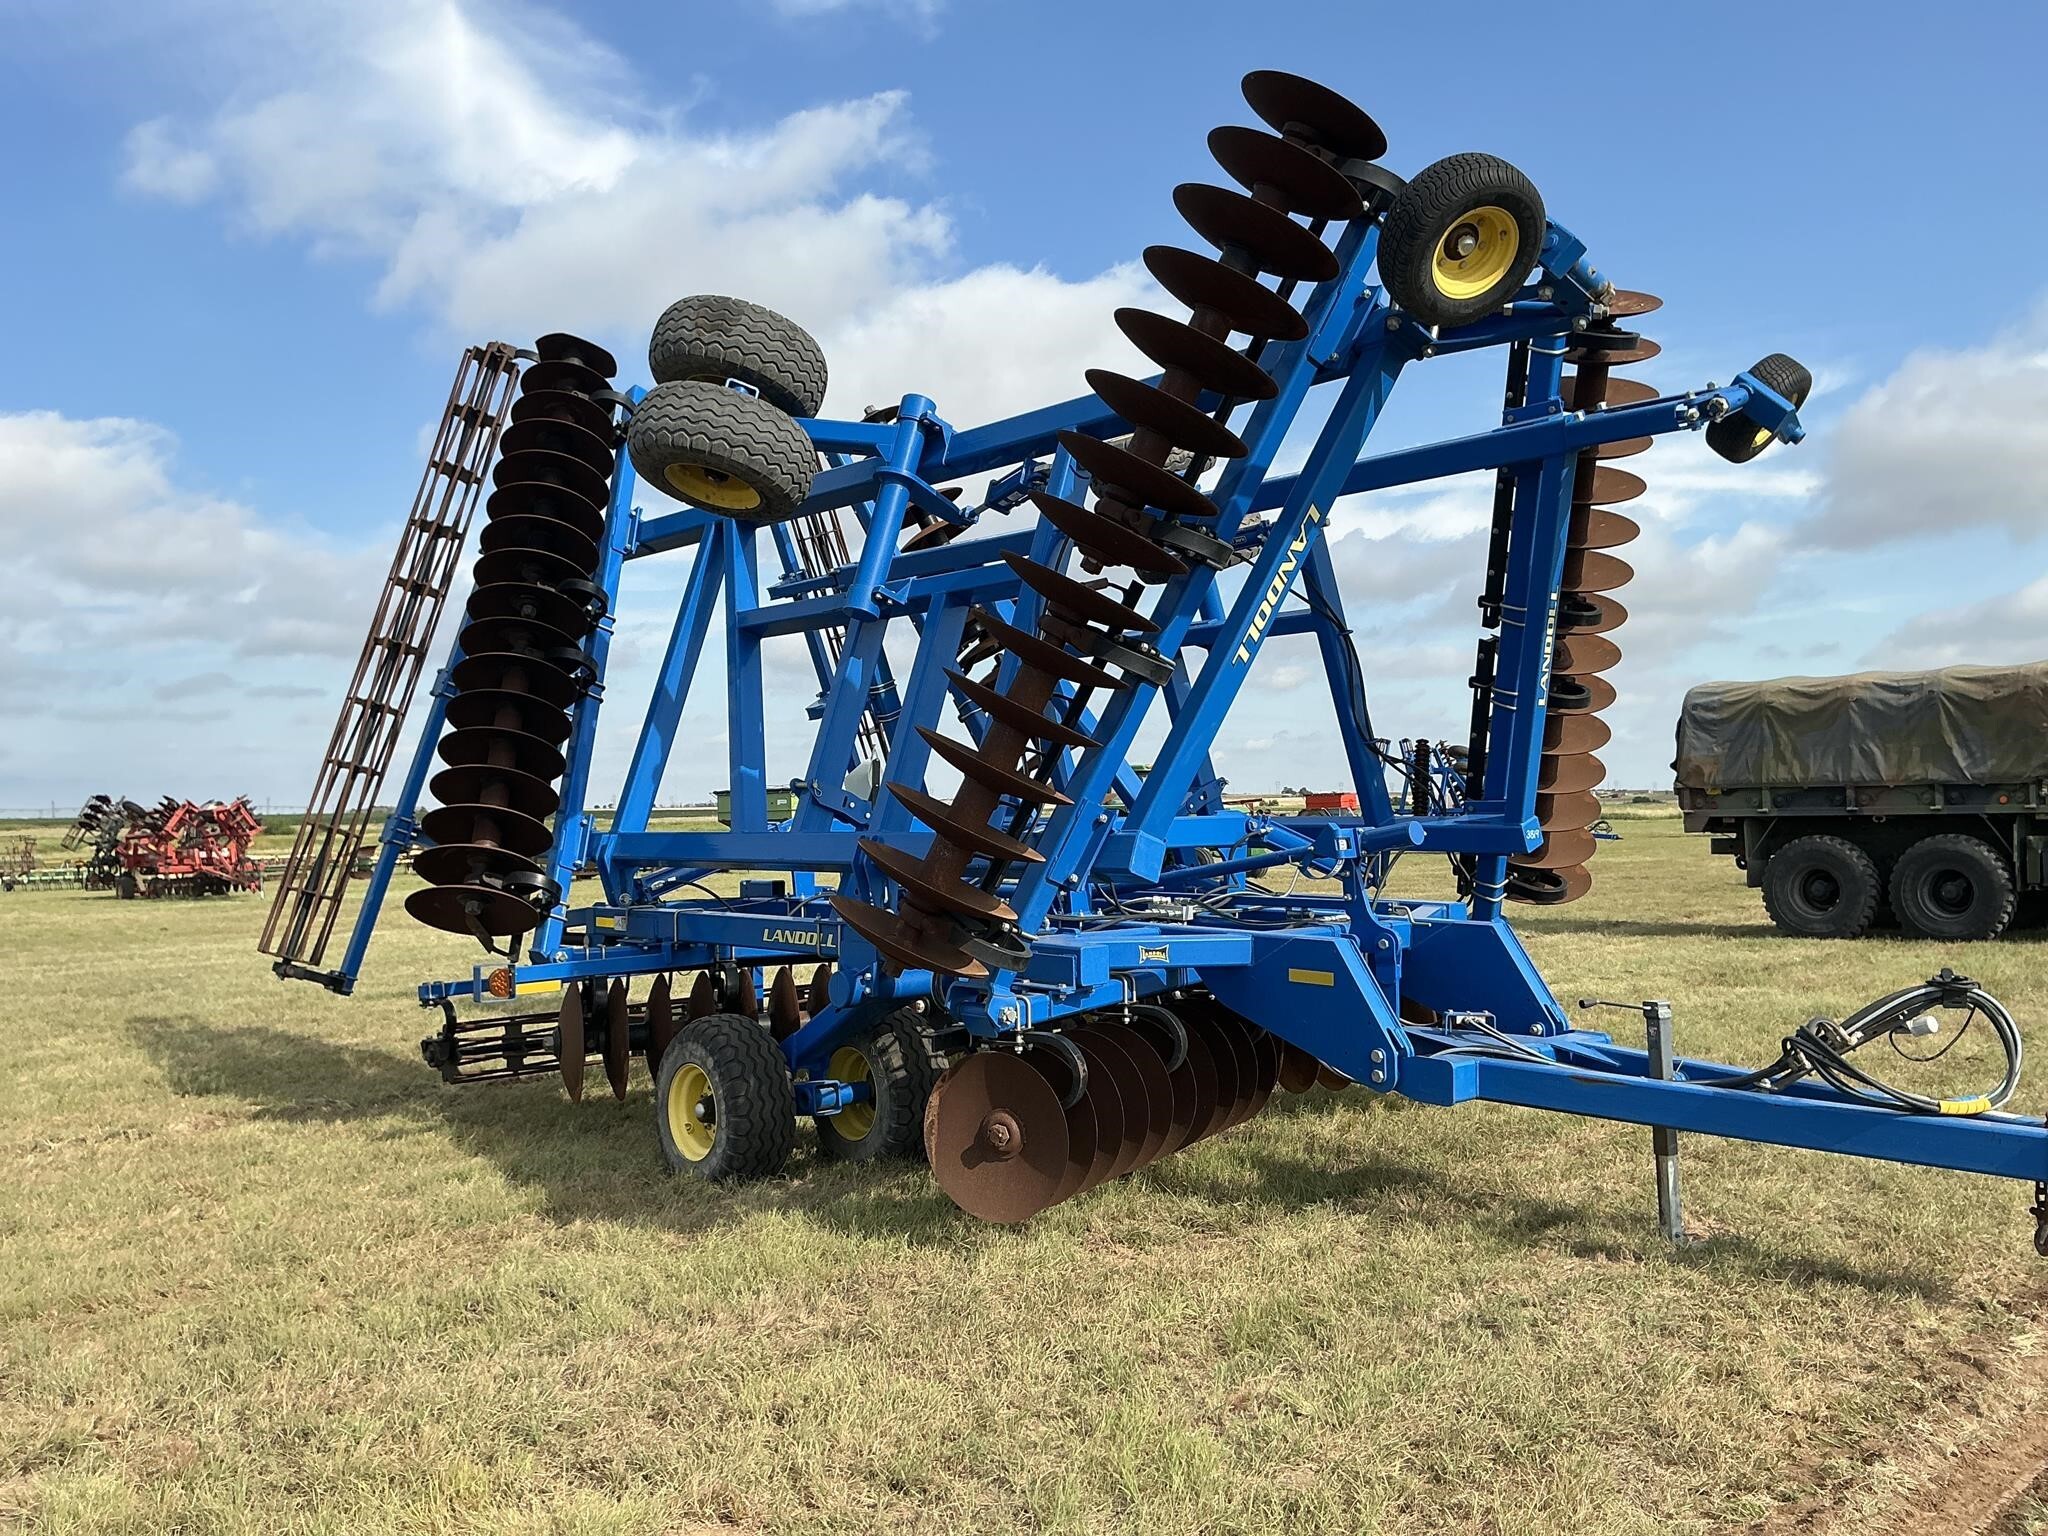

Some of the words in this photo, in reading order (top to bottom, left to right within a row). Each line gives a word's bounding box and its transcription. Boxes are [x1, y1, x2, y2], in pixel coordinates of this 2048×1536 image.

[1231, 503, 1322, 666] LANDOLL
[1538, 585, 1559, 706] LANDOLL
[763, 928, 837, 948] LANDOLL
